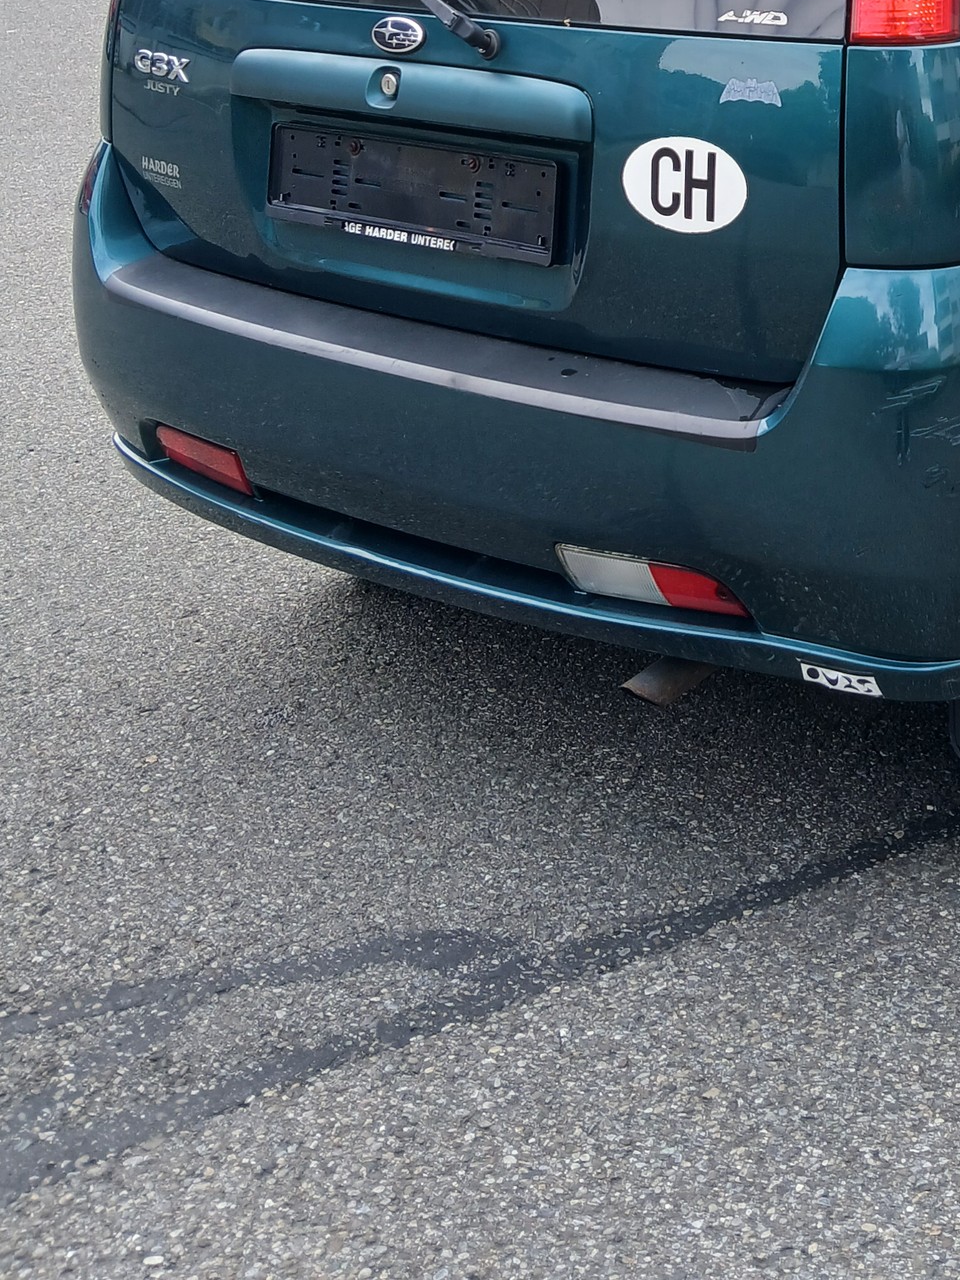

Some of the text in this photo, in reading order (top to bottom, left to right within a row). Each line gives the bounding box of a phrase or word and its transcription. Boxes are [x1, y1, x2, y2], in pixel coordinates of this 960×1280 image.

[134, 49, 191, 83] G3X
[143, 79, 180, 96] JUSTY
[141, 155, 180, 178] HARDER
[650, 146, 717, 223] CH
[365, 225, 408, 243] HARDER
